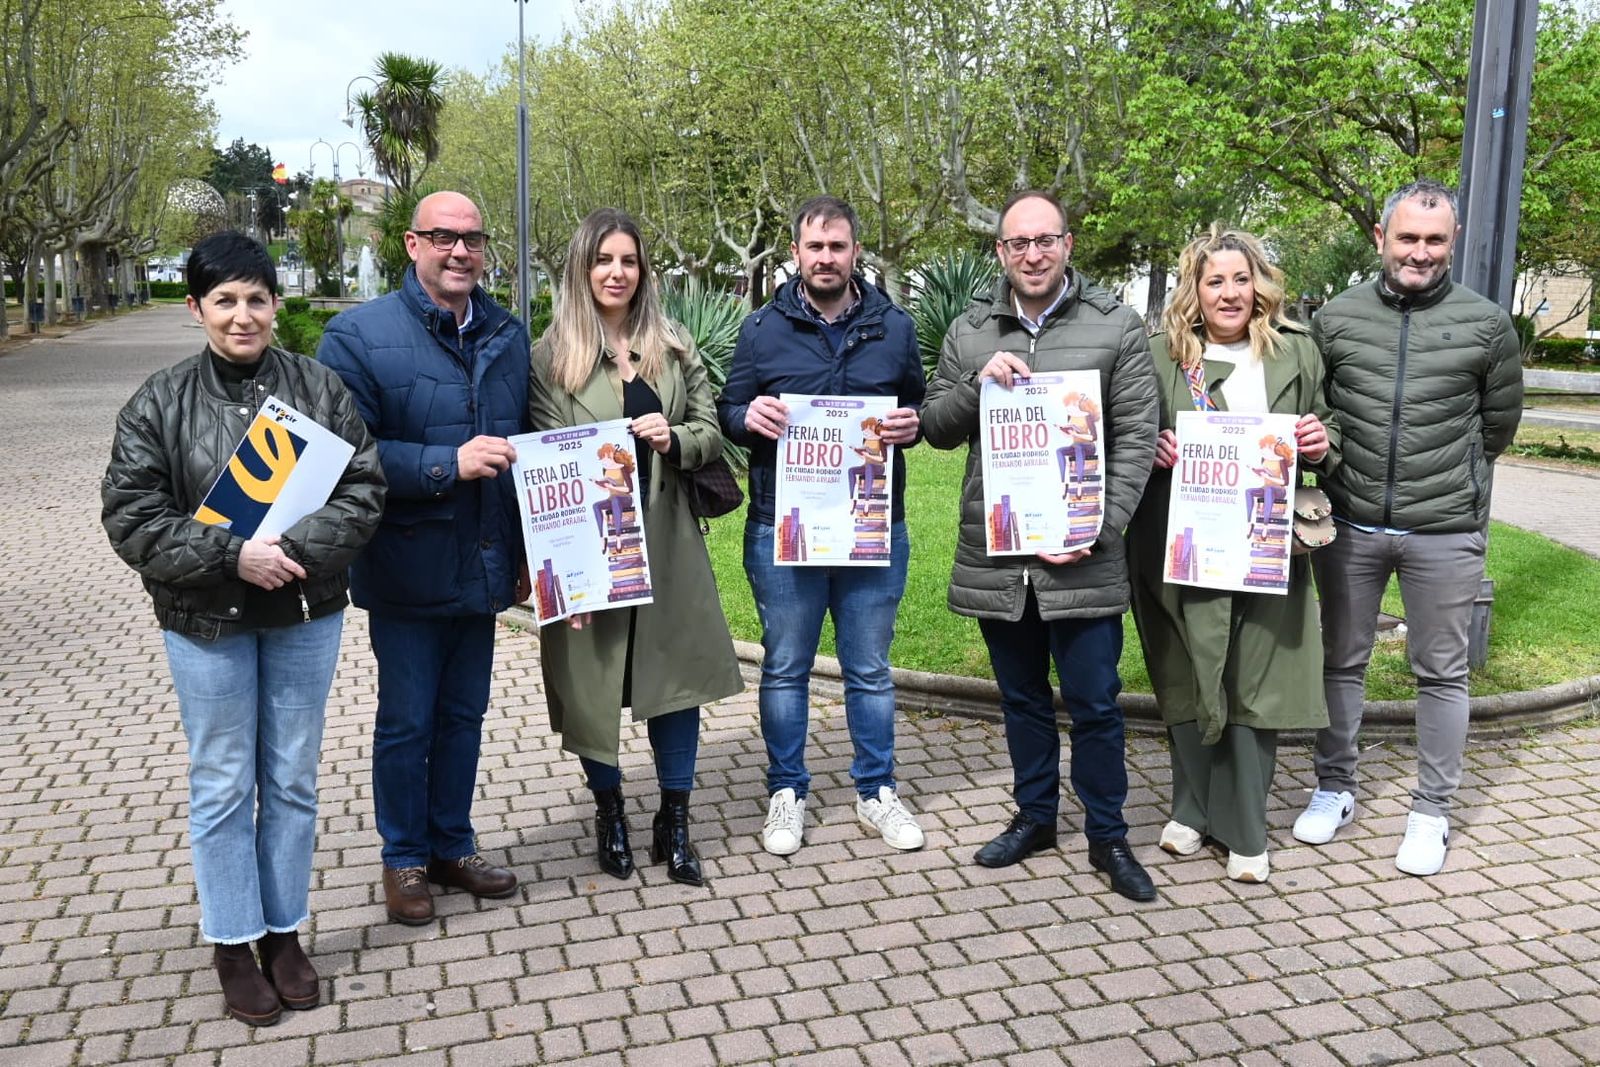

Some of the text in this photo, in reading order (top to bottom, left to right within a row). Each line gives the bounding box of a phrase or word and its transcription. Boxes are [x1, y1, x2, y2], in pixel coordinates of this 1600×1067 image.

[1025, 386, 1048, 395] 2025
[826, 409, 848, 417] 2025
[989, 405, 1046, 424] FERIA DEL
[787, 425, 843, 443] FERIA DEL
[990, 423, 1049, 452] LIBRO
[1222, 426, 1246, 434] 2025
[558, 441, 582, 451] 2025
[786, 441, 843, 468] LIBRO
[1022, 450, 1049, 458] RODRIGO
[1182, 443, 1240, 460] FERIA DEL
[523, 461, 582, 487] FERIA DEL
[1181, 460, 1239, 487] LIBRO
[527, 479, 584, 515] LIBRO
[540, 513, 560, 522] CIUDAD
[561, 507, 586, 517] RODRIGO
[532, 520, 560, 533] FERNANDO
